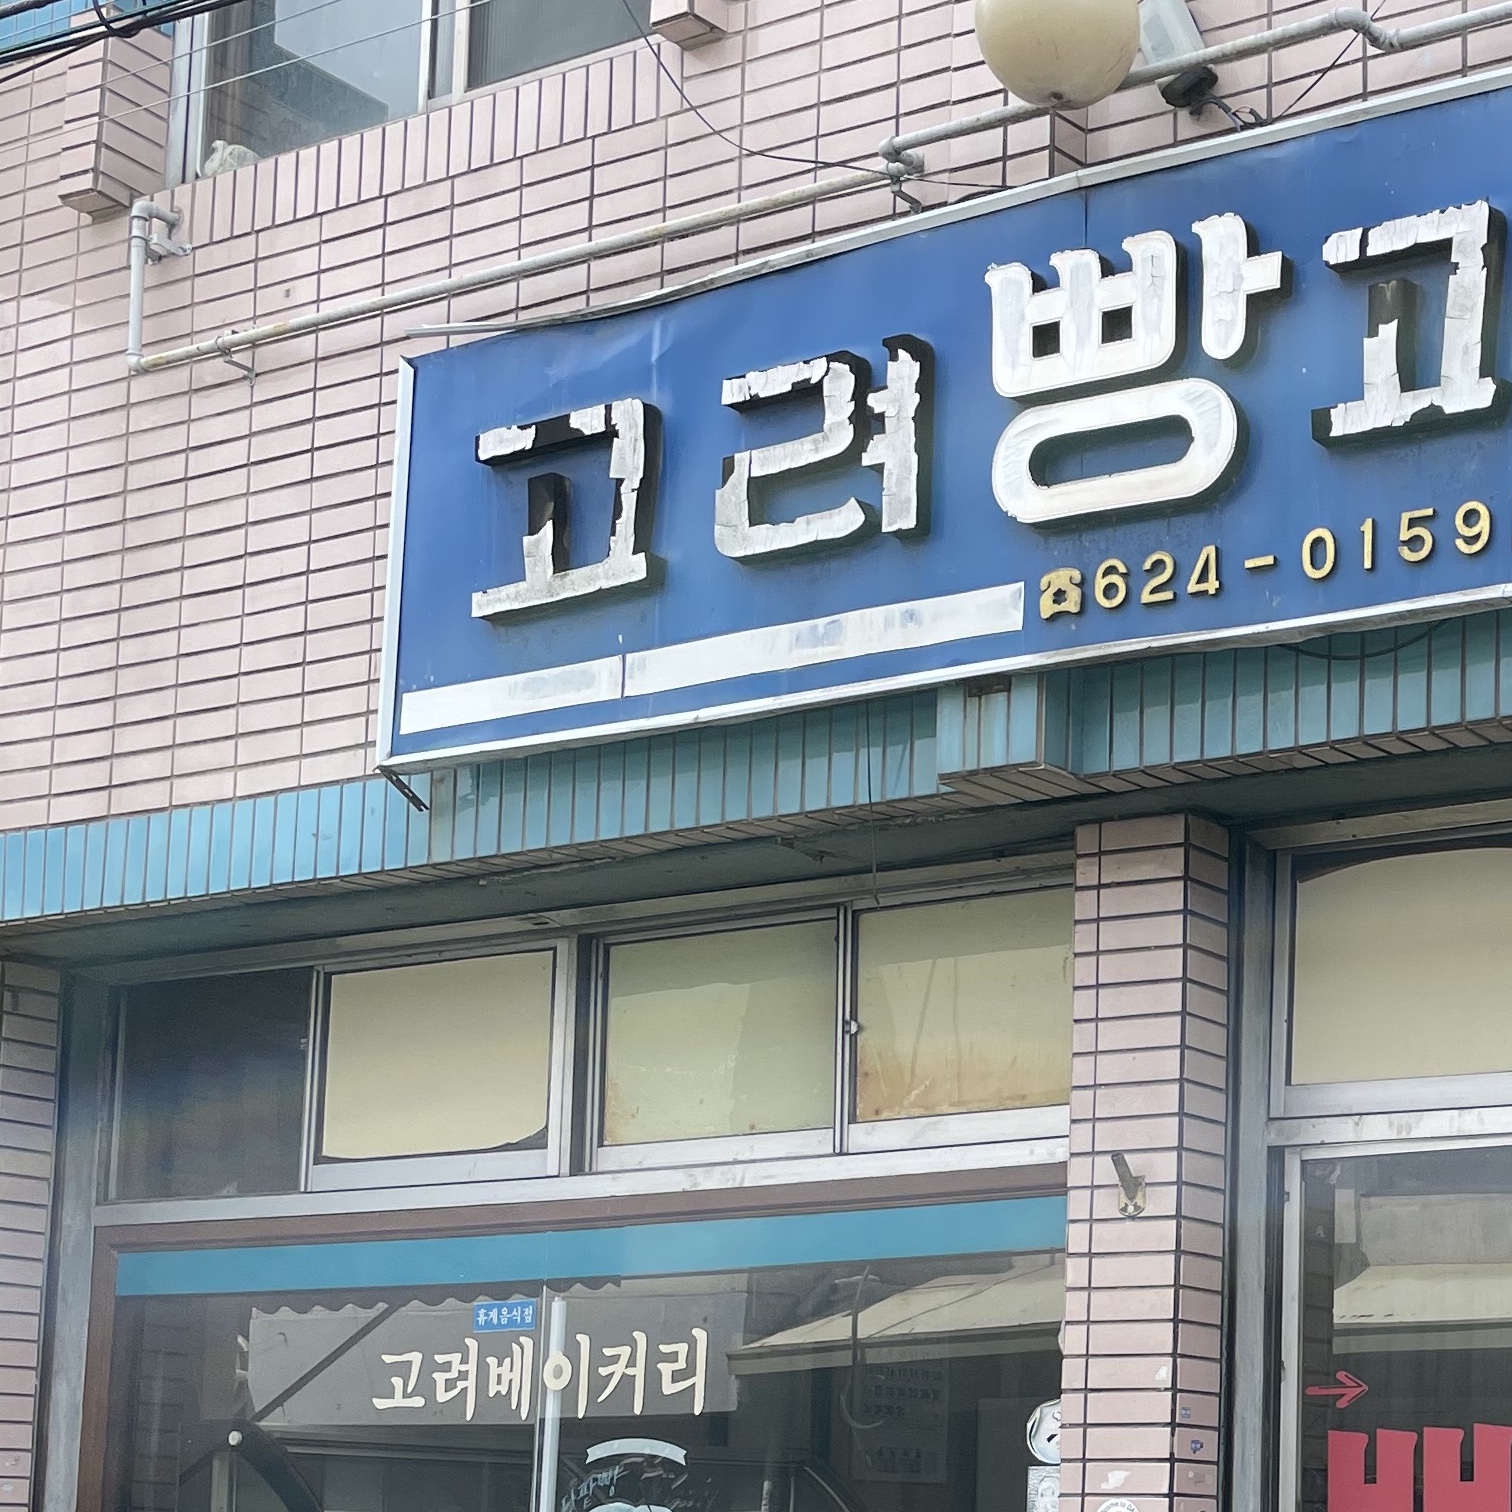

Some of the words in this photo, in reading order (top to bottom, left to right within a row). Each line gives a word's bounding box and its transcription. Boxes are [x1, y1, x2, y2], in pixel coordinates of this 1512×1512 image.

[1093, 500, 1491, 610] 624-0159
[476, 1304, 534, 1326] 휴게음식점
[372, 1327, 708, 1422] 고려베이커리
